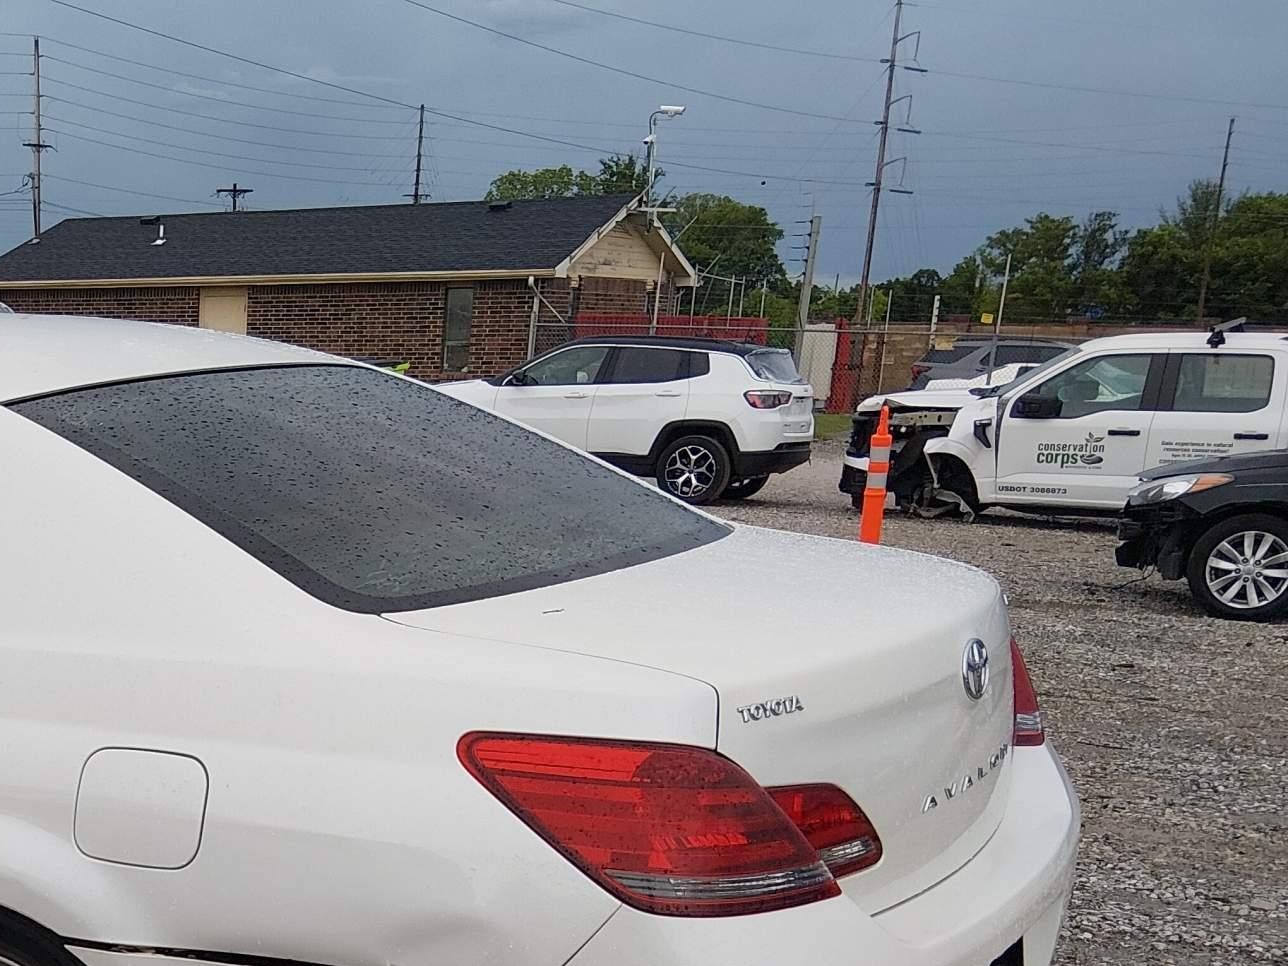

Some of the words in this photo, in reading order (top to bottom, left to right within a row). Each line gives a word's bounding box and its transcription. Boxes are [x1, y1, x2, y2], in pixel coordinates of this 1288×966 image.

[1037, 442, 1105, 453] conservation
[1036, 452, 1079, 469] corps
[998, 485, 1027, 493] USDOT
[737, 695, 805, 723] TOYOTA
[921, 743, 1008, 814] AVALON
